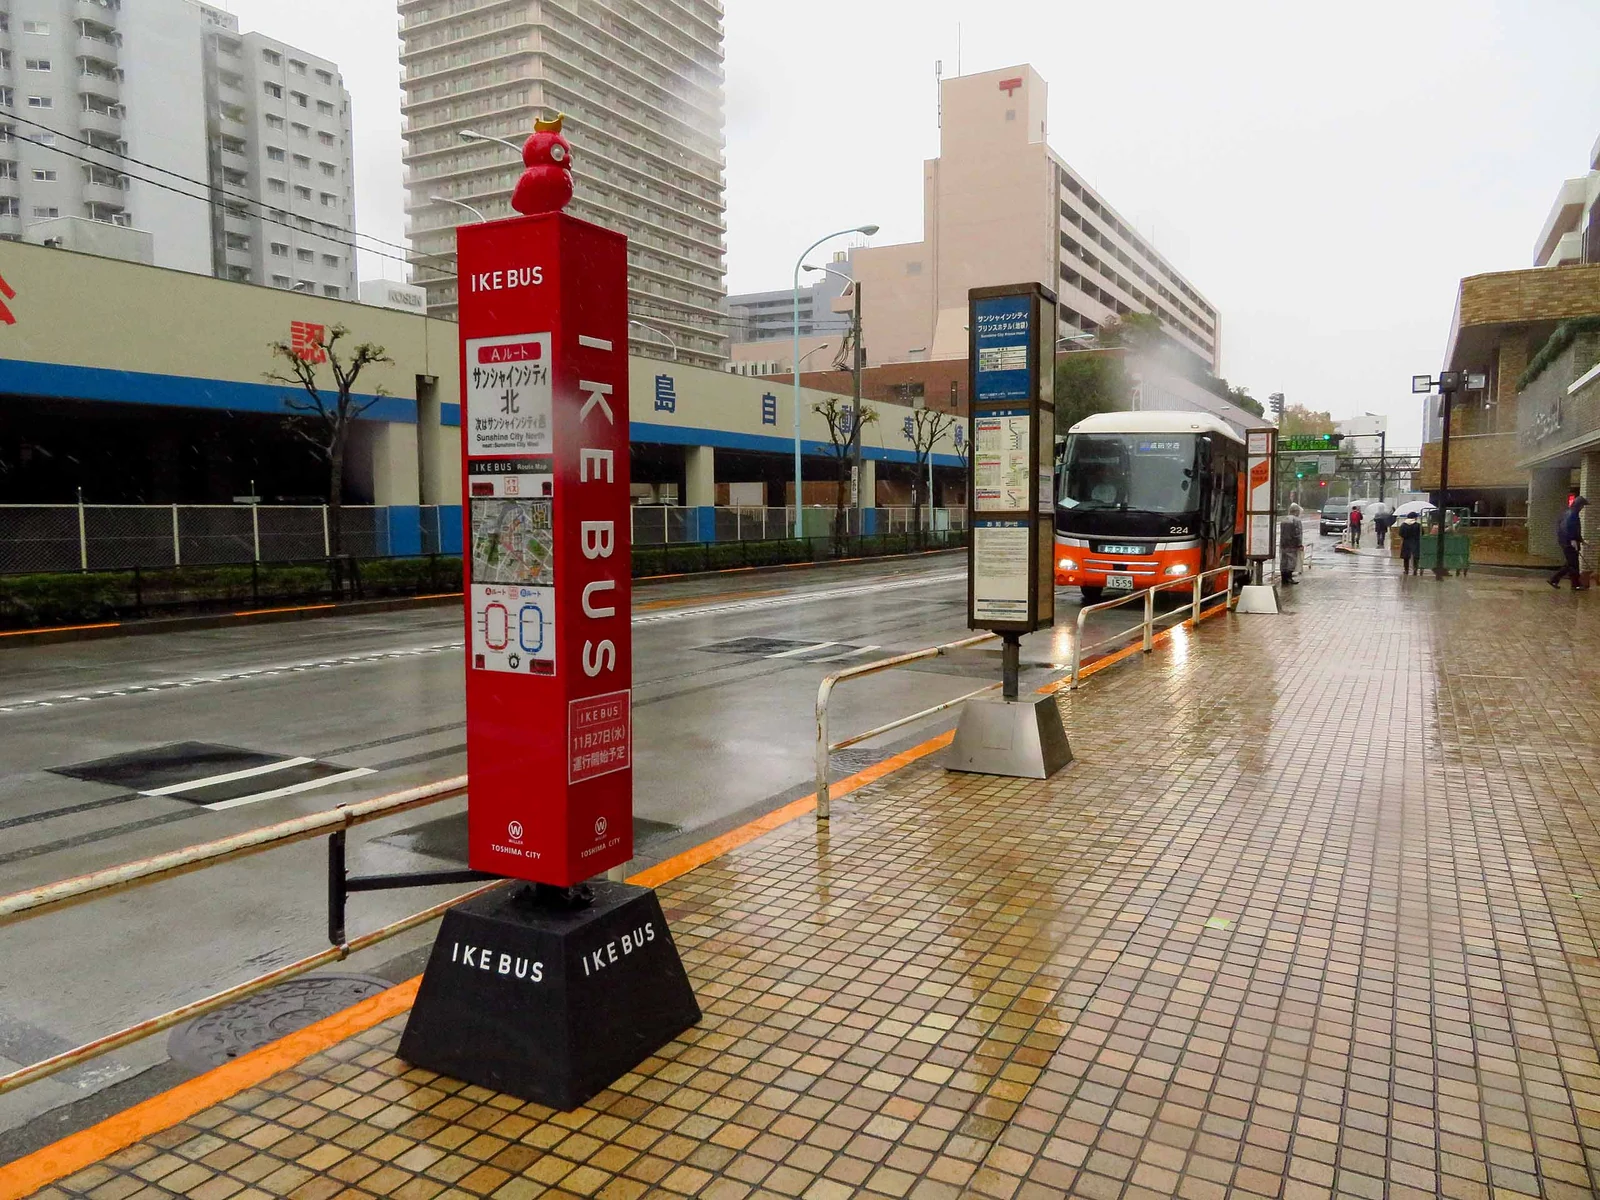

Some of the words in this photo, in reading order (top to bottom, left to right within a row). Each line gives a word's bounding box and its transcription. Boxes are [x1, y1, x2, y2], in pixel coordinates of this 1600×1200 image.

[472, 271, 502, 292] IKE
[508, 266, 543, 288] BUS
[473, 364, 547, 389] サンシャインシティ
[501, 389, 519, 414] 北
[654, 374, 676, 413] 島
[579, 334, 614, 484] IKE
[476, 433, 508, 441] Sunshine
[510, 432, 524, 441] City
[475, 463, 492, 472] IKE
[495, 462, 512, 471] BUS
[1170, 526, 1188, 534] 224
[581, 521, 616, 677] BUS
[580, 710, 598, 723] IKE
[600, 706, 618, 719] BUS
[573, 725, 625, 751] 11月27日(水)
[572, 746, 625, 772] 運行開始予定
[491, 844, 522, 856] TOSHIMA
[525, 850, 541, 859] CITY
[581, 843, 607, 858] TOSHIMA
[608, 837, 620, 847] CITY
[582, 942, 618, 976] IKE
[621, 922, 655, 955] BUS
[452, 943, 493, 970] IKE
[498, 953, 544, 983] BUS
